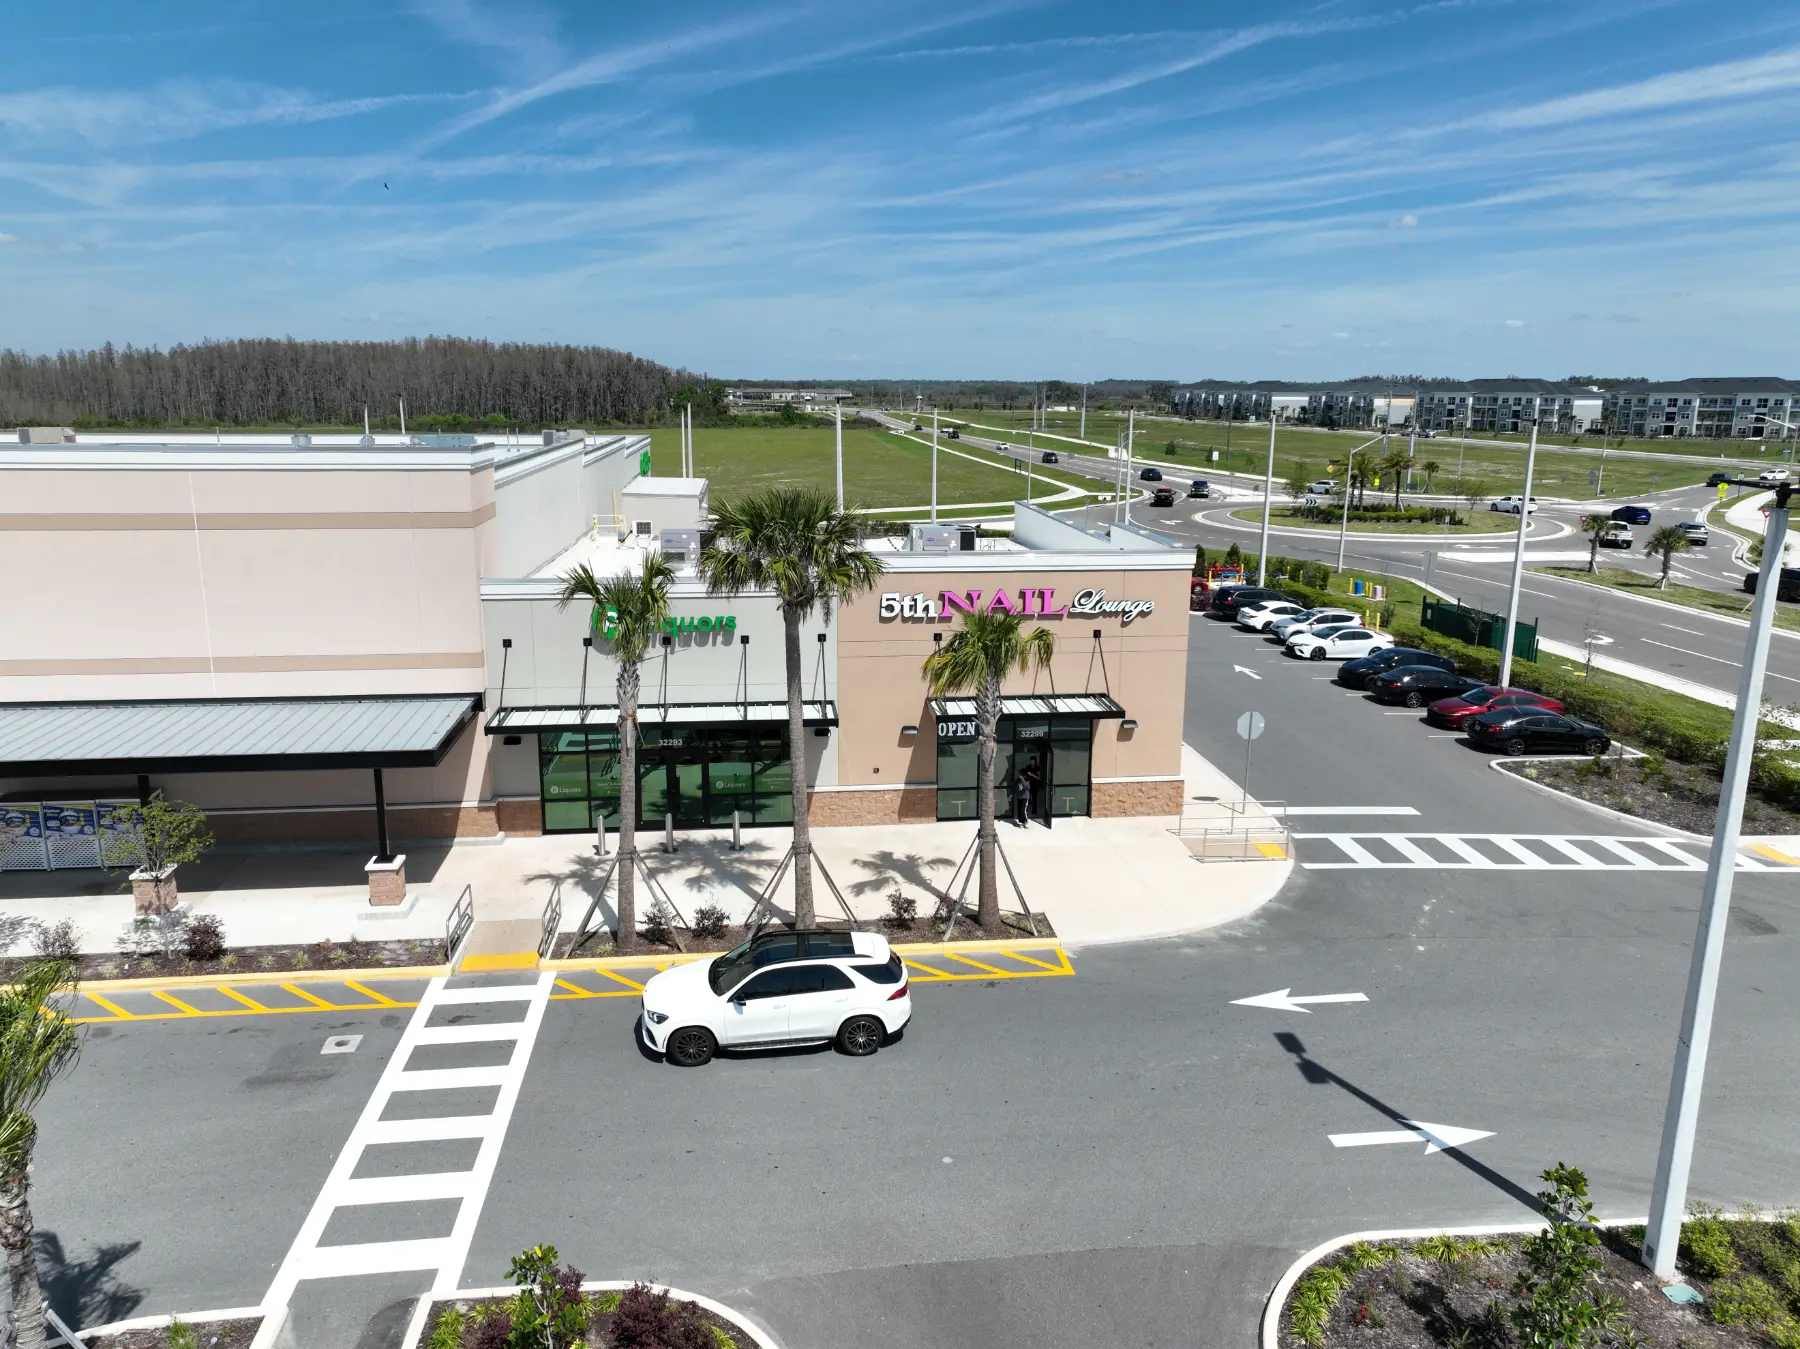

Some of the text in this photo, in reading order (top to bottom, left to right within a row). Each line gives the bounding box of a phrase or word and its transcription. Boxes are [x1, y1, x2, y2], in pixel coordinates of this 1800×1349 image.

[880, 588, 1156, 622] 5th NAIL Lounge
[648, 614, 737, 639] quors
[938, 721, 976, 736] OPEN
[1020, 730, 1044, 738] 32299
[658, 738, 683, 746] 32293
[725, 781, 746, 789] Liquors
